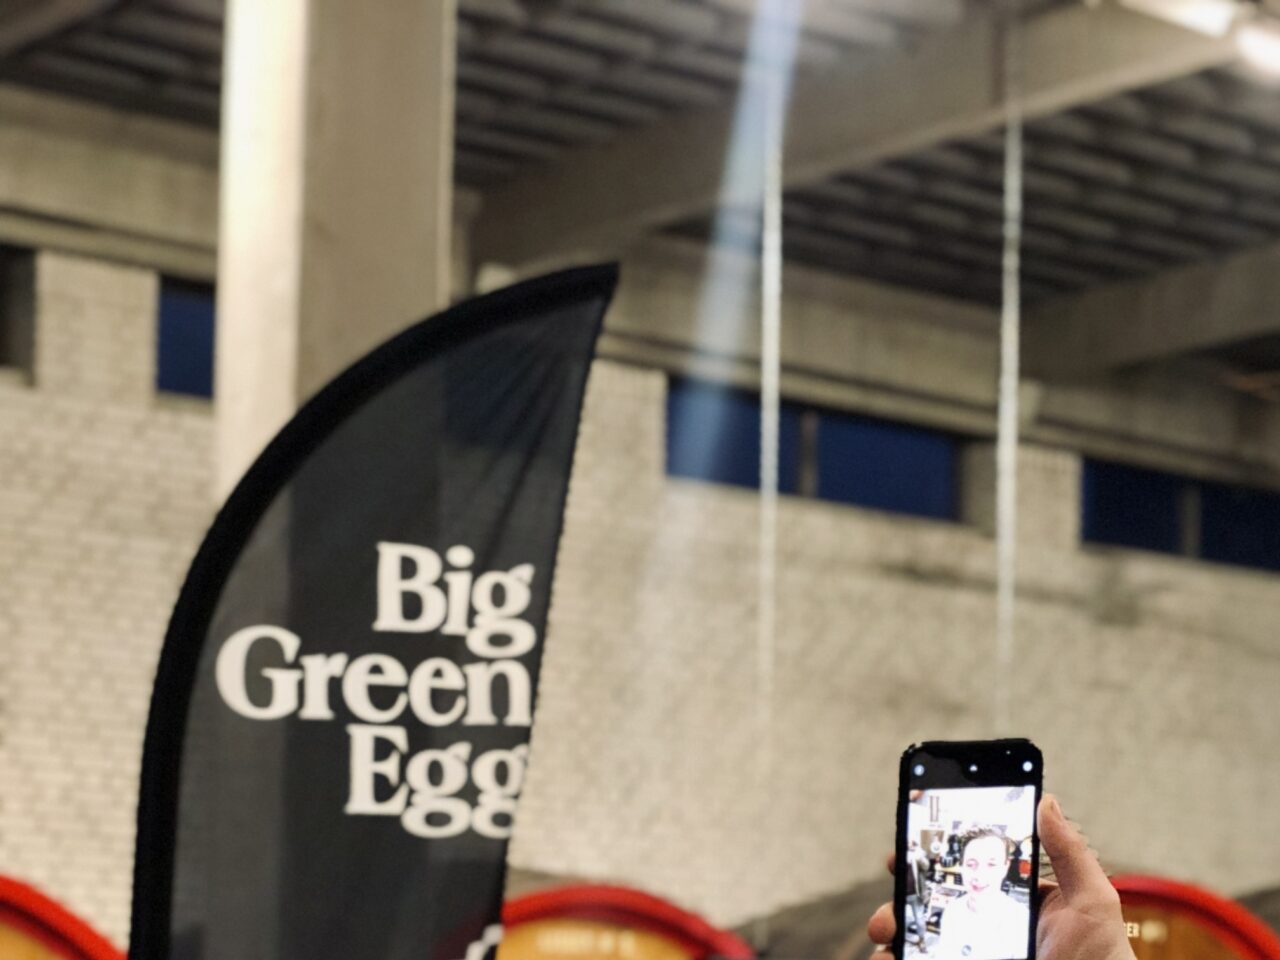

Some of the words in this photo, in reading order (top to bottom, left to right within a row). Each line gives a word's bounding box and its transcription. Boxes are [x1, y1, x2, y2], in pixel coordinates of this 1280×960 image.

[373, 541, 537, 658] Big
[215, 625, 533, 726] Green
[344, 723, 529, 838] Egg
